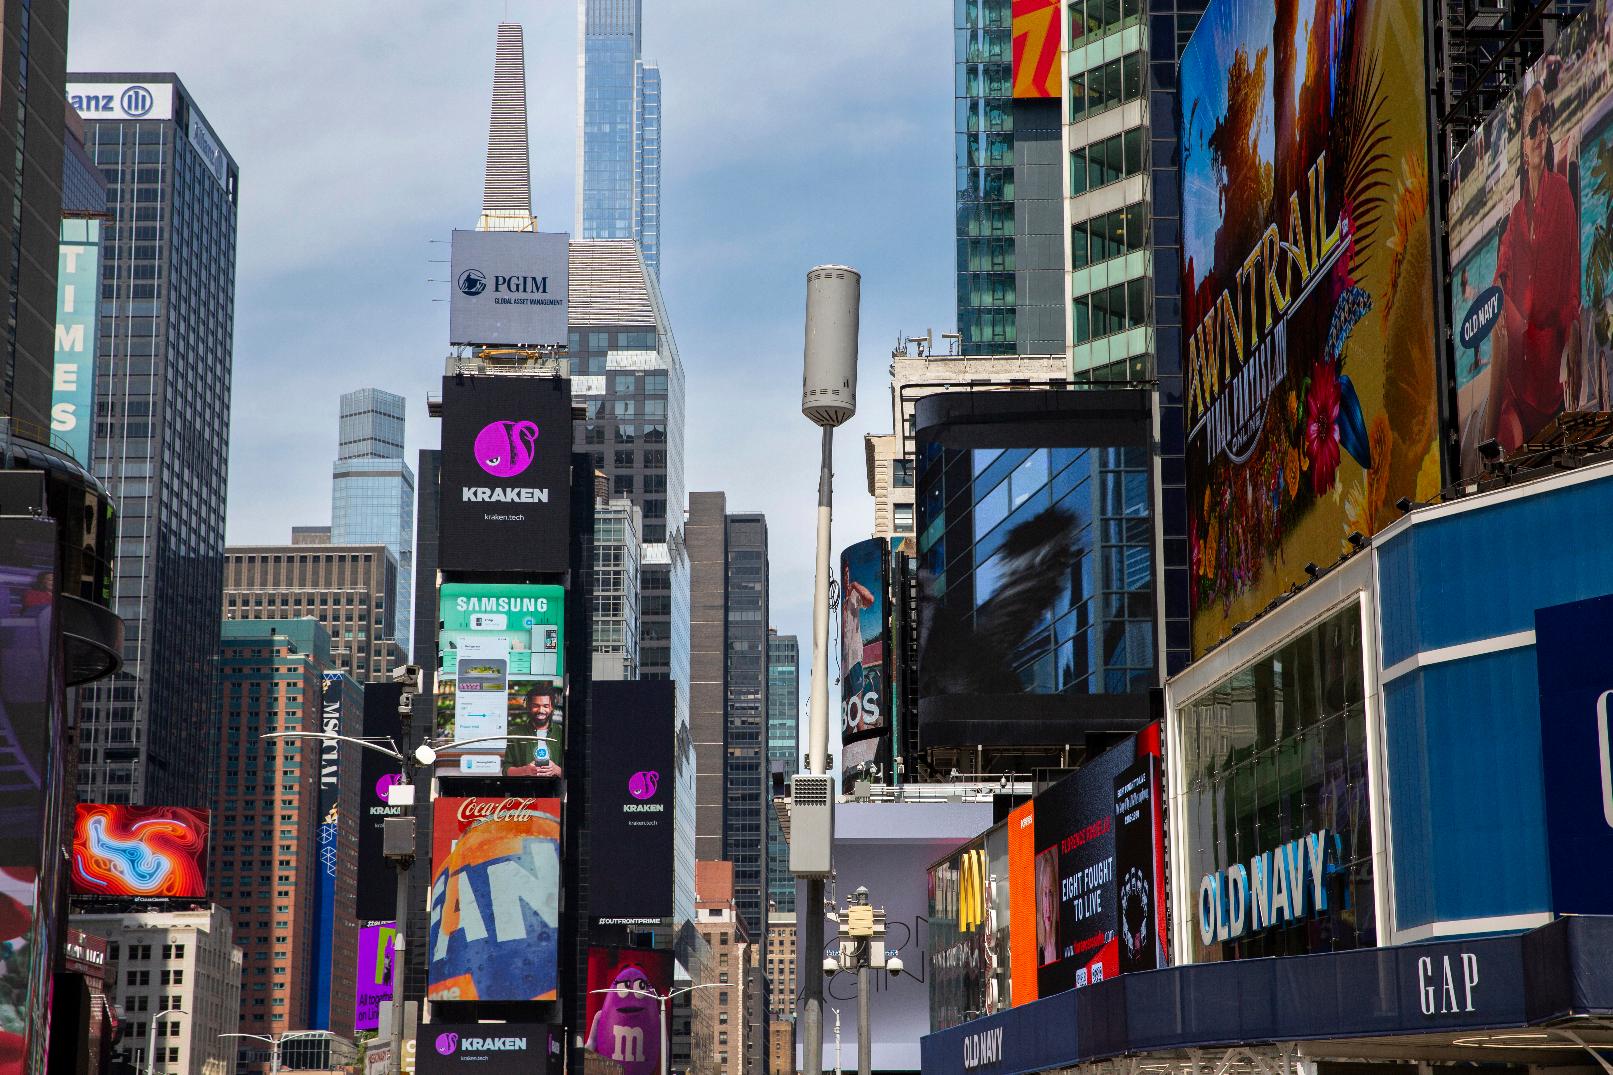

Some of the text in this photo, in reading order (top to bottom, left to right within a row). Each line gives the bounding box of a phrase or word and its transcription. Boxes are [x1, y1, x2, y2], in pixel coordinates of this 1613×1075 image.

[494, 275, 549, 294] PGIM
[1188, 149, 1341, 431] AWNTRAIL
[494, 297, 513, 305] GLOBAL
[1464, 292, 1499, 341] OLD NAVY
[51, 248, 85, 432] TIMES
[462, 486, 549, 503] KRAKEN
[484, 513, 525, 521] kraken.tech
[456, 596, 548, 612] SAMSUNG
[370, 806, 400, 815] KRAK
[457, 796, 536, 822] Coca-Cola
[623, 804, 664, 812] KRAKEN
[1062, 856, 1113, 902] EIGHT FOUGHT
[1199, 828, 1327, 946] OLD NAVY
[1073, 889, 1102, 922] TO LIVE
[598, 917, 661, 925] #OUTFRONTPRIME
[1418, 953, 1479, 1015] GAP
[461, 1037, 527, 1051] KRAKEN
[964, 1026, 1003, 1069] OLD NAVY
